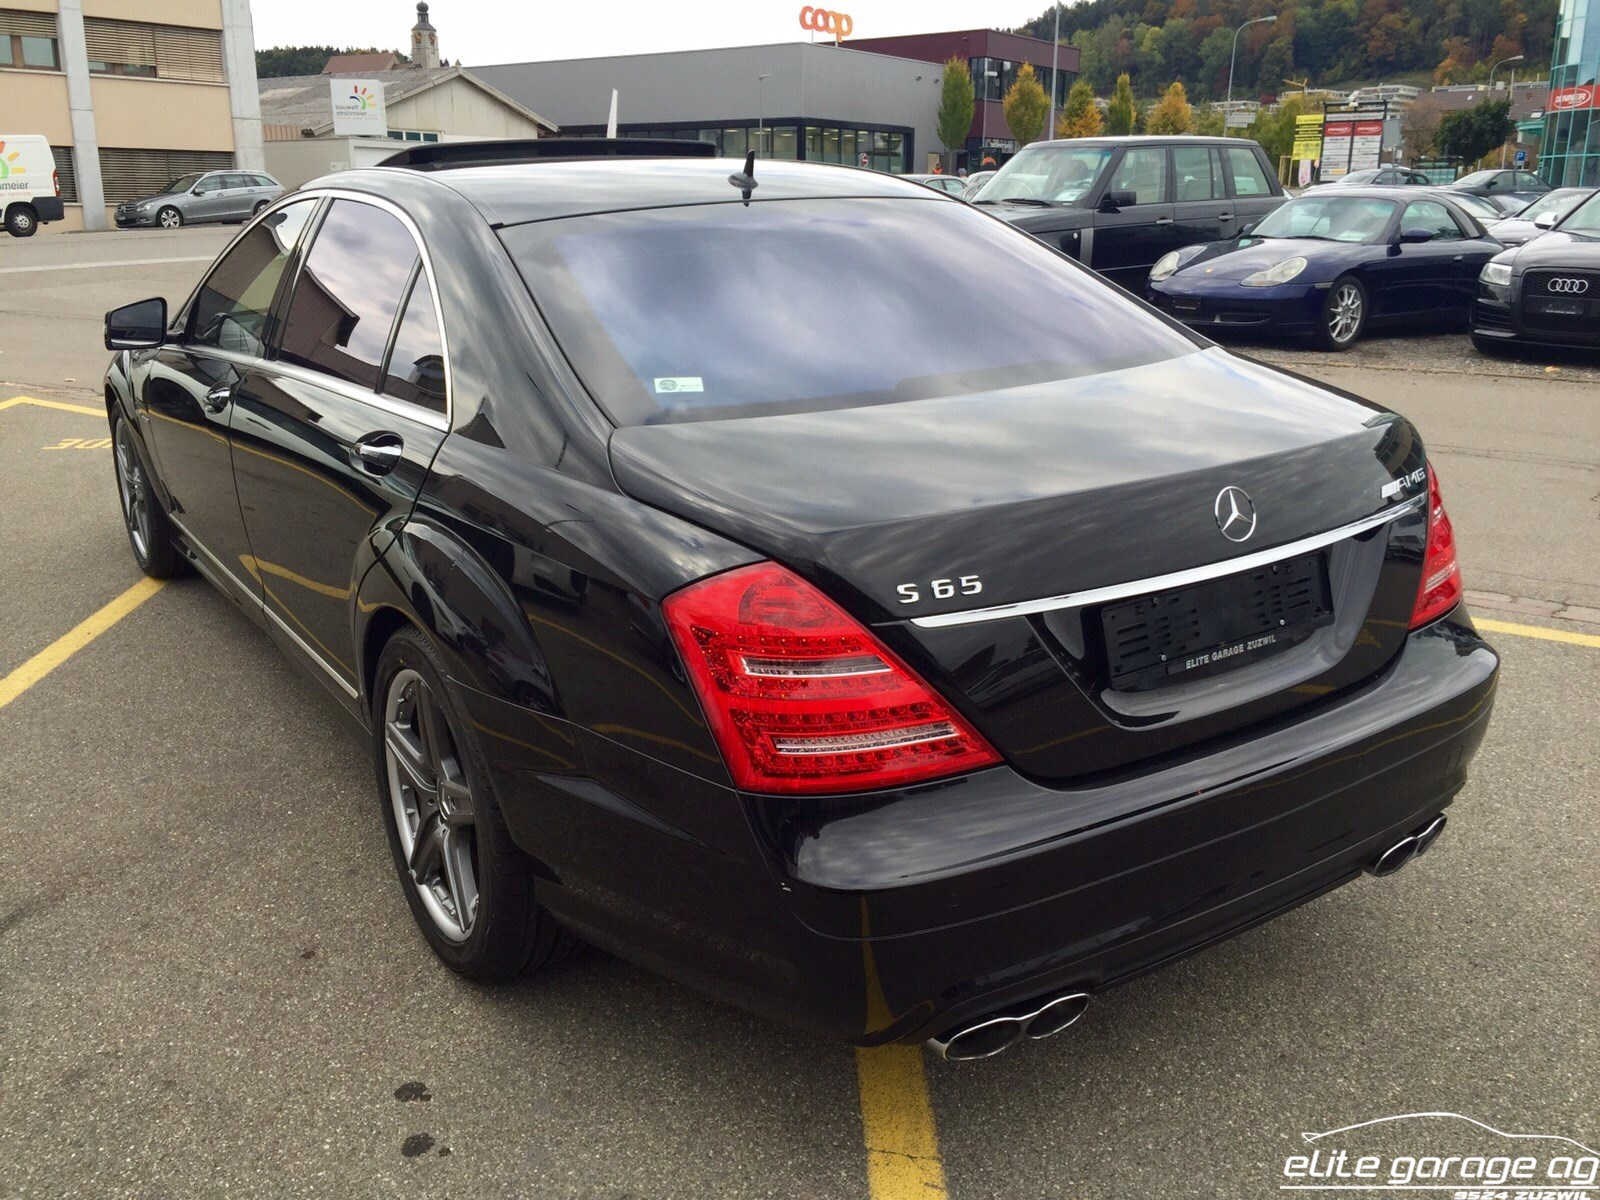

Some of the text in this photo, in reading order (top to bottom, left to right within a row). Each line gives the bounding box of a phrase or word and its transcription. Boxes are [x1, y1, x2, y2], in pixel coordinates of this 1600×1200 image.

[799, 5, 853, 42] coop
[0, 181, 29, 190] meier
[1396, 467, 1426, 492] AMG
[896, 574, 983, 604] S 65
[1185, 634, 1277, 670] ELITE GARAGE ZUZWIL
